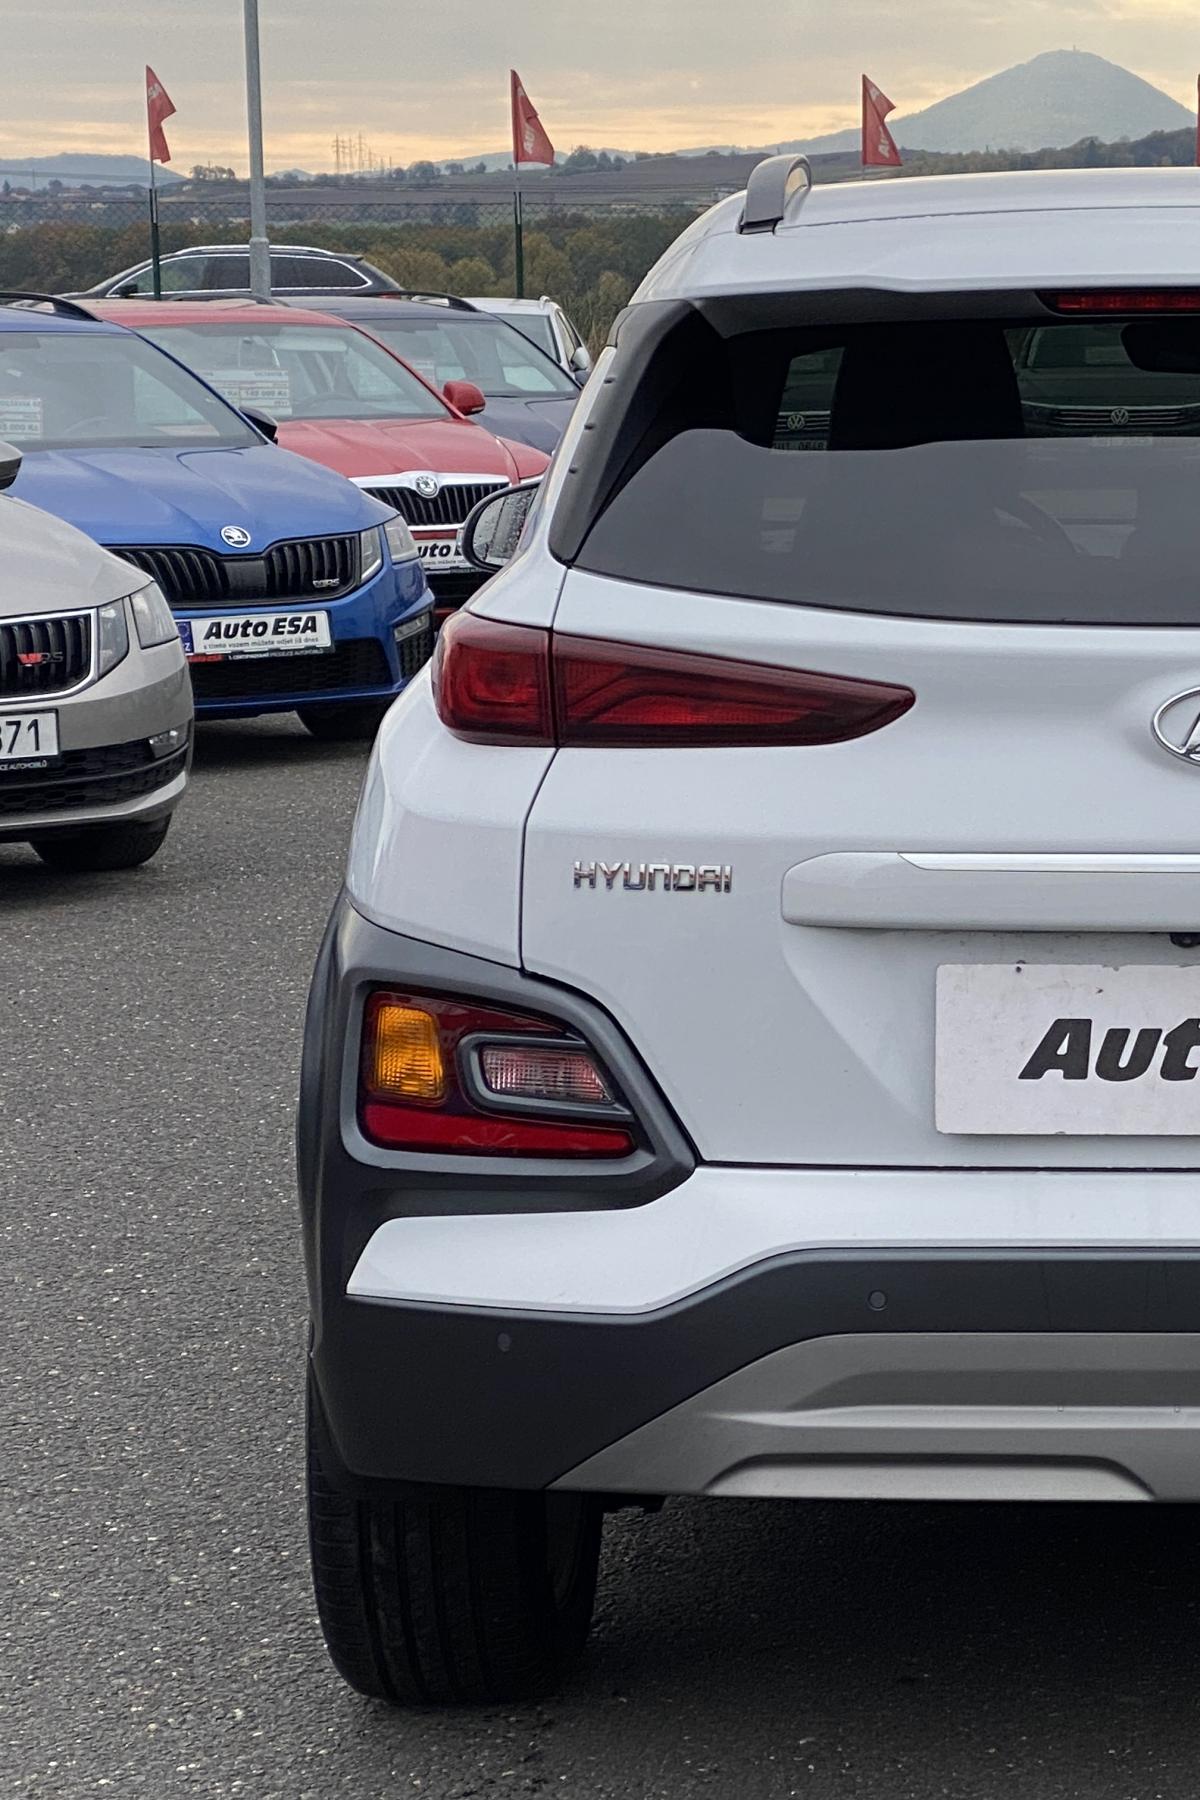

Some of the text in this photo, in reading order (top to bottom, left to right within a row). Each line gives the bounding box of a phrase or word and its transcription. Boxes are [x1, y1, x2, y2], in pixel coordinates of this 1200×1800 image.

[417, 543, 451, 559] uto
[203, 615, 317, 640] Auto ESA
[573, 861, 733, 894] HYUNDAI
